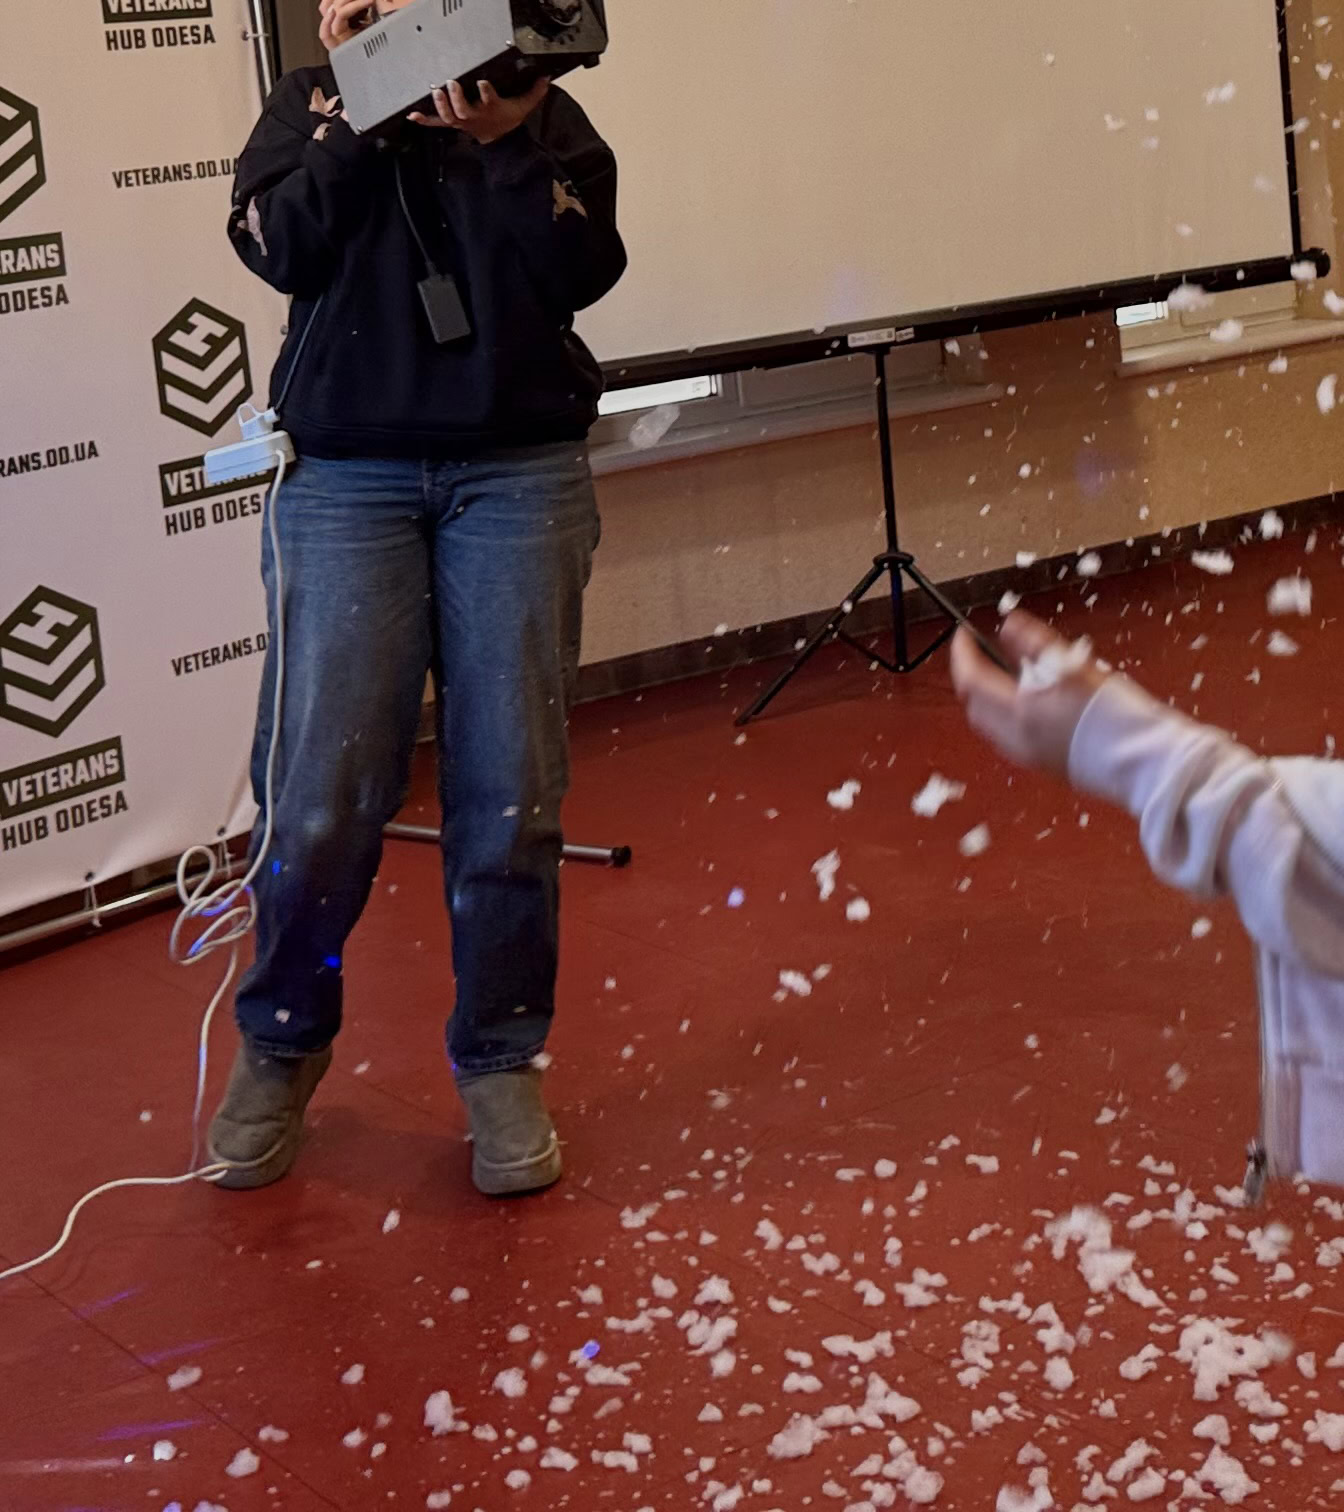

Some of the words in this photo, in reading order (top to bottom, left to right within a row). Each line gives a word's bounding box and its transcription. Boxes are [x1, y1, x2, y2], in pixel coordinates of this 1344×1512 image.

[106, 29, 146, 50] HUB
[152, 25, 215, 47] ODESA
[165, 507, 206, 536] HUB
[212, 493, 261, 524] ODES
[171, 632, 270, 677] VETERANS.O
[3, 749, 119, 806] VETERANS
[2, 816, 48, 851] HUB
[56, 791, 128, 832] ODESA
